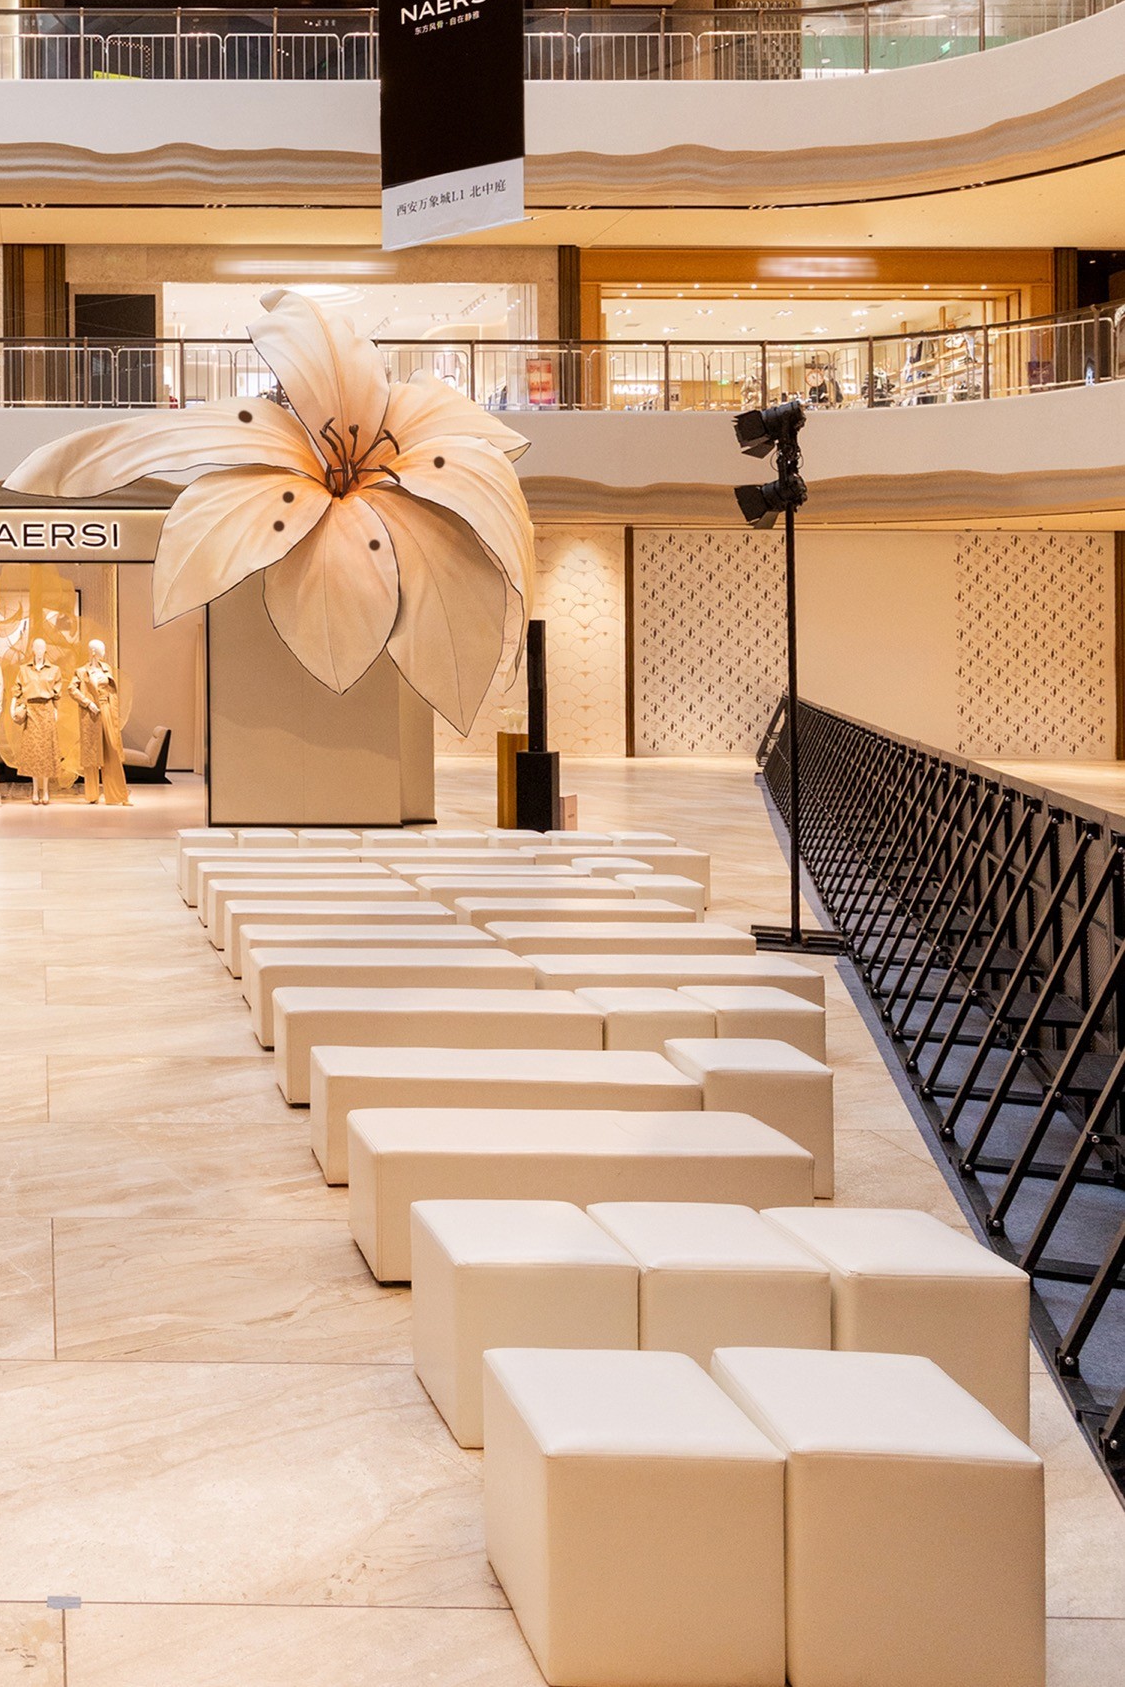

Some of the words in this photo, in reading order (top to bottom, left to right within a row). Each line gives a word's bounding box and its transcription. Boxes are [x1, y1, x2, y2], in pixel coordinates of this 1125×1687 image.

[396, 189, 465, 216] 西安万象城L1
[469, 179, 506, 198] 北中庭
